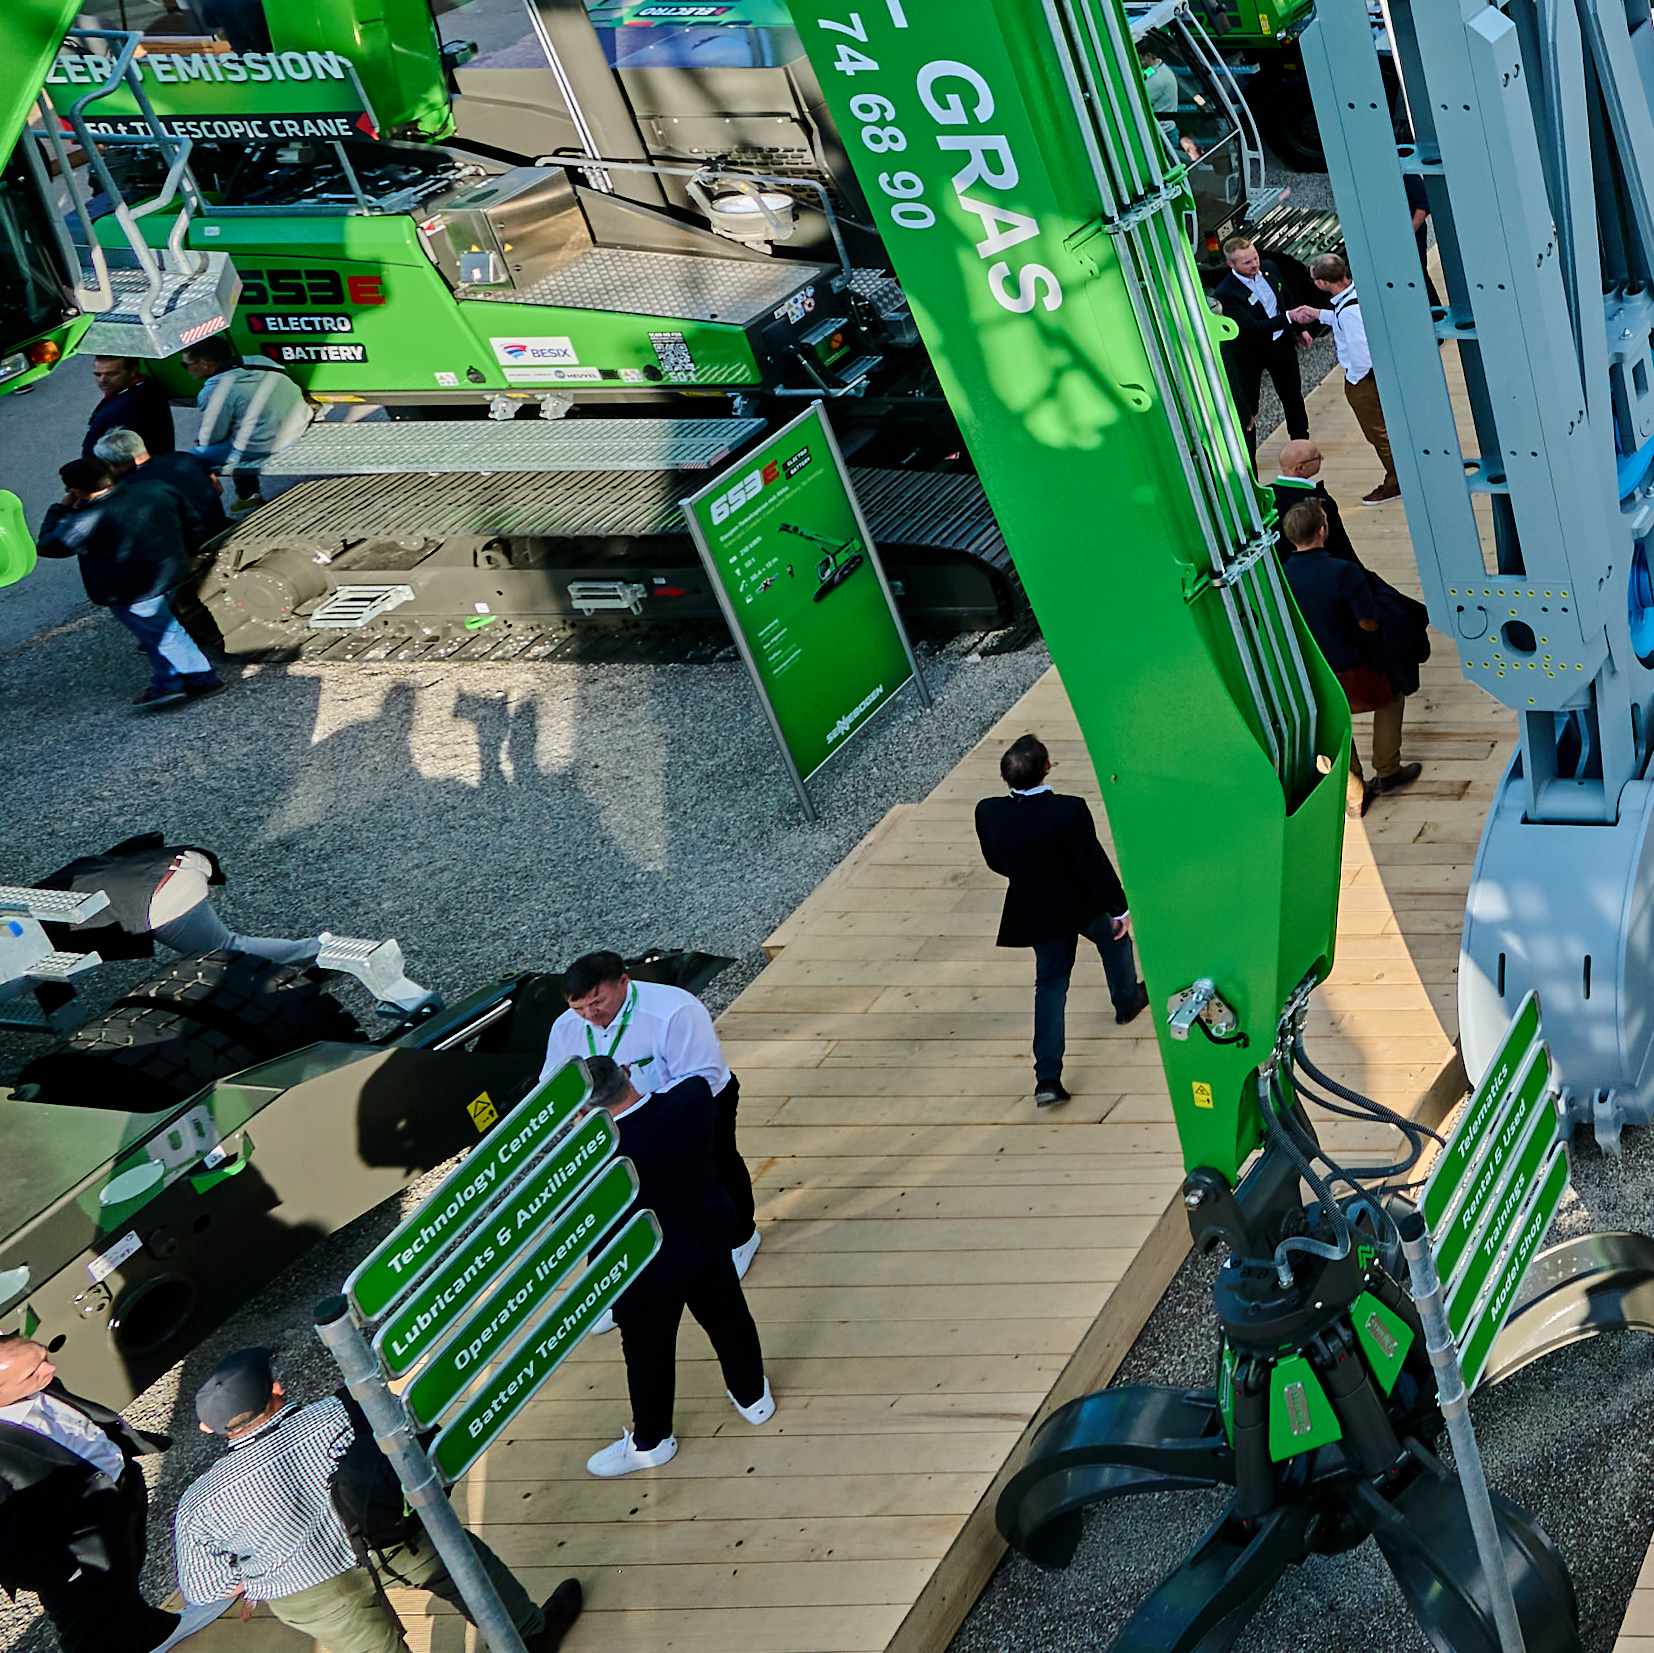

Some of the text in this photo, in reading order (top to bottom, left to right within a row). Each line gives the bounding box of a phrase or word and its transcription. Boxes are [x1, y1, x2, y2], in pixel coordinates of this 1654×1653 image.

[638, 6, 718, 17] ELECTRO
[149, 50, 345, 84] EMISSION
[817, 21, 879, 77] 74
[270, 118, 353, 138] CRANE
[851, 95, 909, 155] 68
[877, 170, 937, 231] 90
[916, 59, 1064, 314] GRAS
[265, 316, 351, 333] ELECTRO
[281, 346, 363, 361] BATTERY
[530, 348, 572, 359] BESIX
[710, 459, 781, 526] 653E
[825, 683, 884, 744] SENNEBOGEN
[1456, 1062, 1510, 1160] Telematics
[387, 1098, 559, 1275] Technology Center
[1460, 1098, 1528, 1232] Rental & Used
[390, 1127, 609, 1357] Lubricants & Auxiliaries
[1482, 1170, 1527, 1259] Trainings
[452, 1211, 597, 1372] Operator license
[1488, 1209, 1543, 1322] Model Shop
[467, 1251, 631, 1439] Battery Technology
